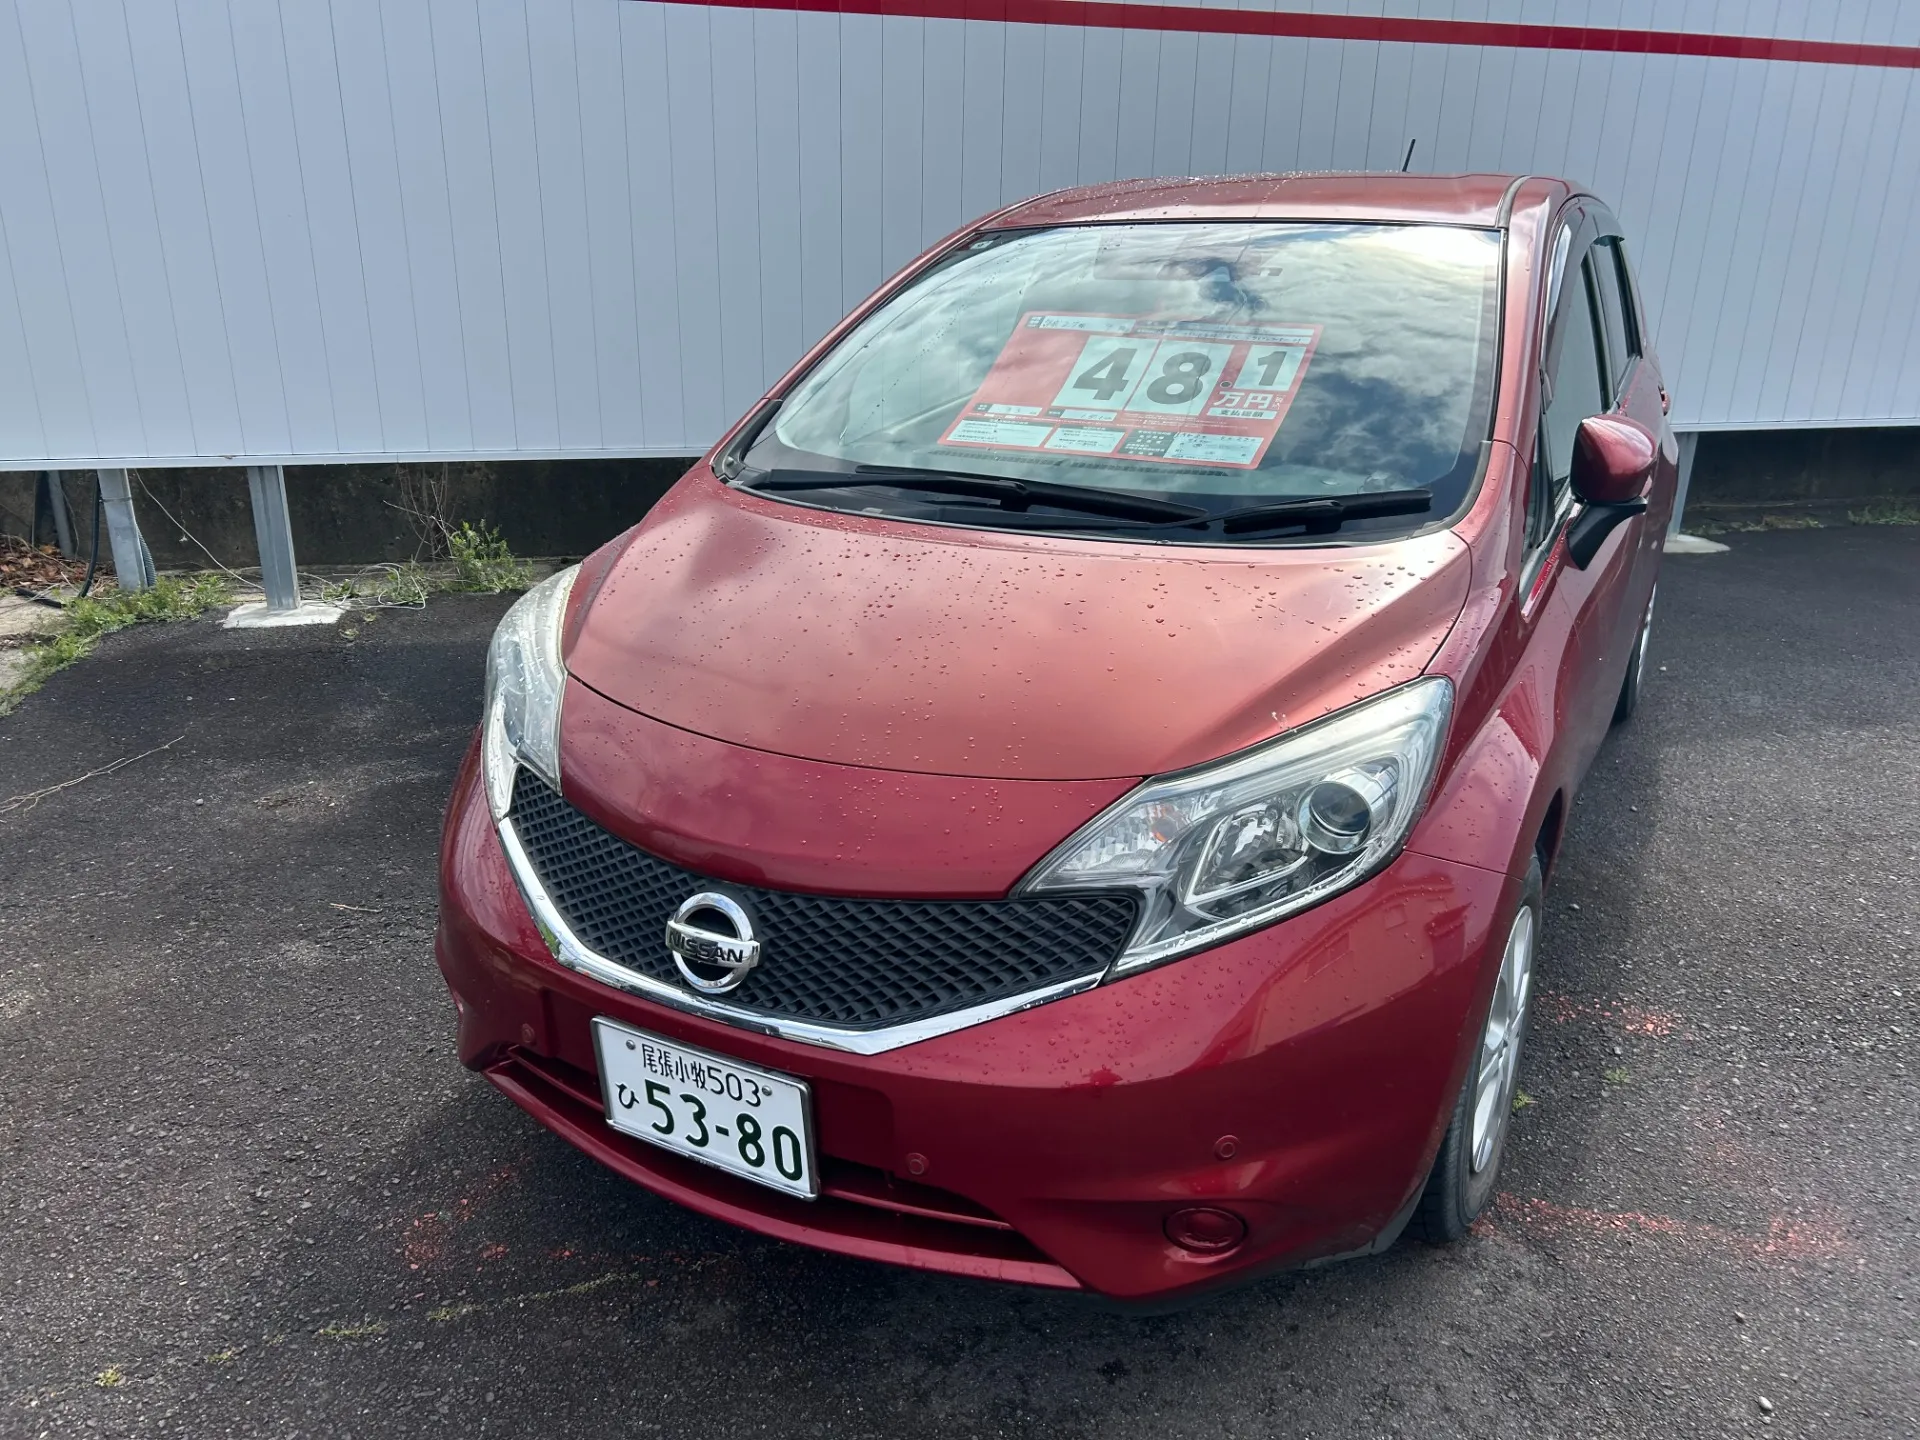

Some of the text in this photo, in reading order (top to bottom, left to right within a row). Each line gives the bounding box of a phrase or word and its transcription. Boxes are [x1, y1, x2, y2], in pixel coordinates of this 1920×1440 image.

[1212, 391, 1274, 409] 万円
[668, 929, 744, 964] NISSAN
[615, 1078, 804, 1182] ひ 53-80
